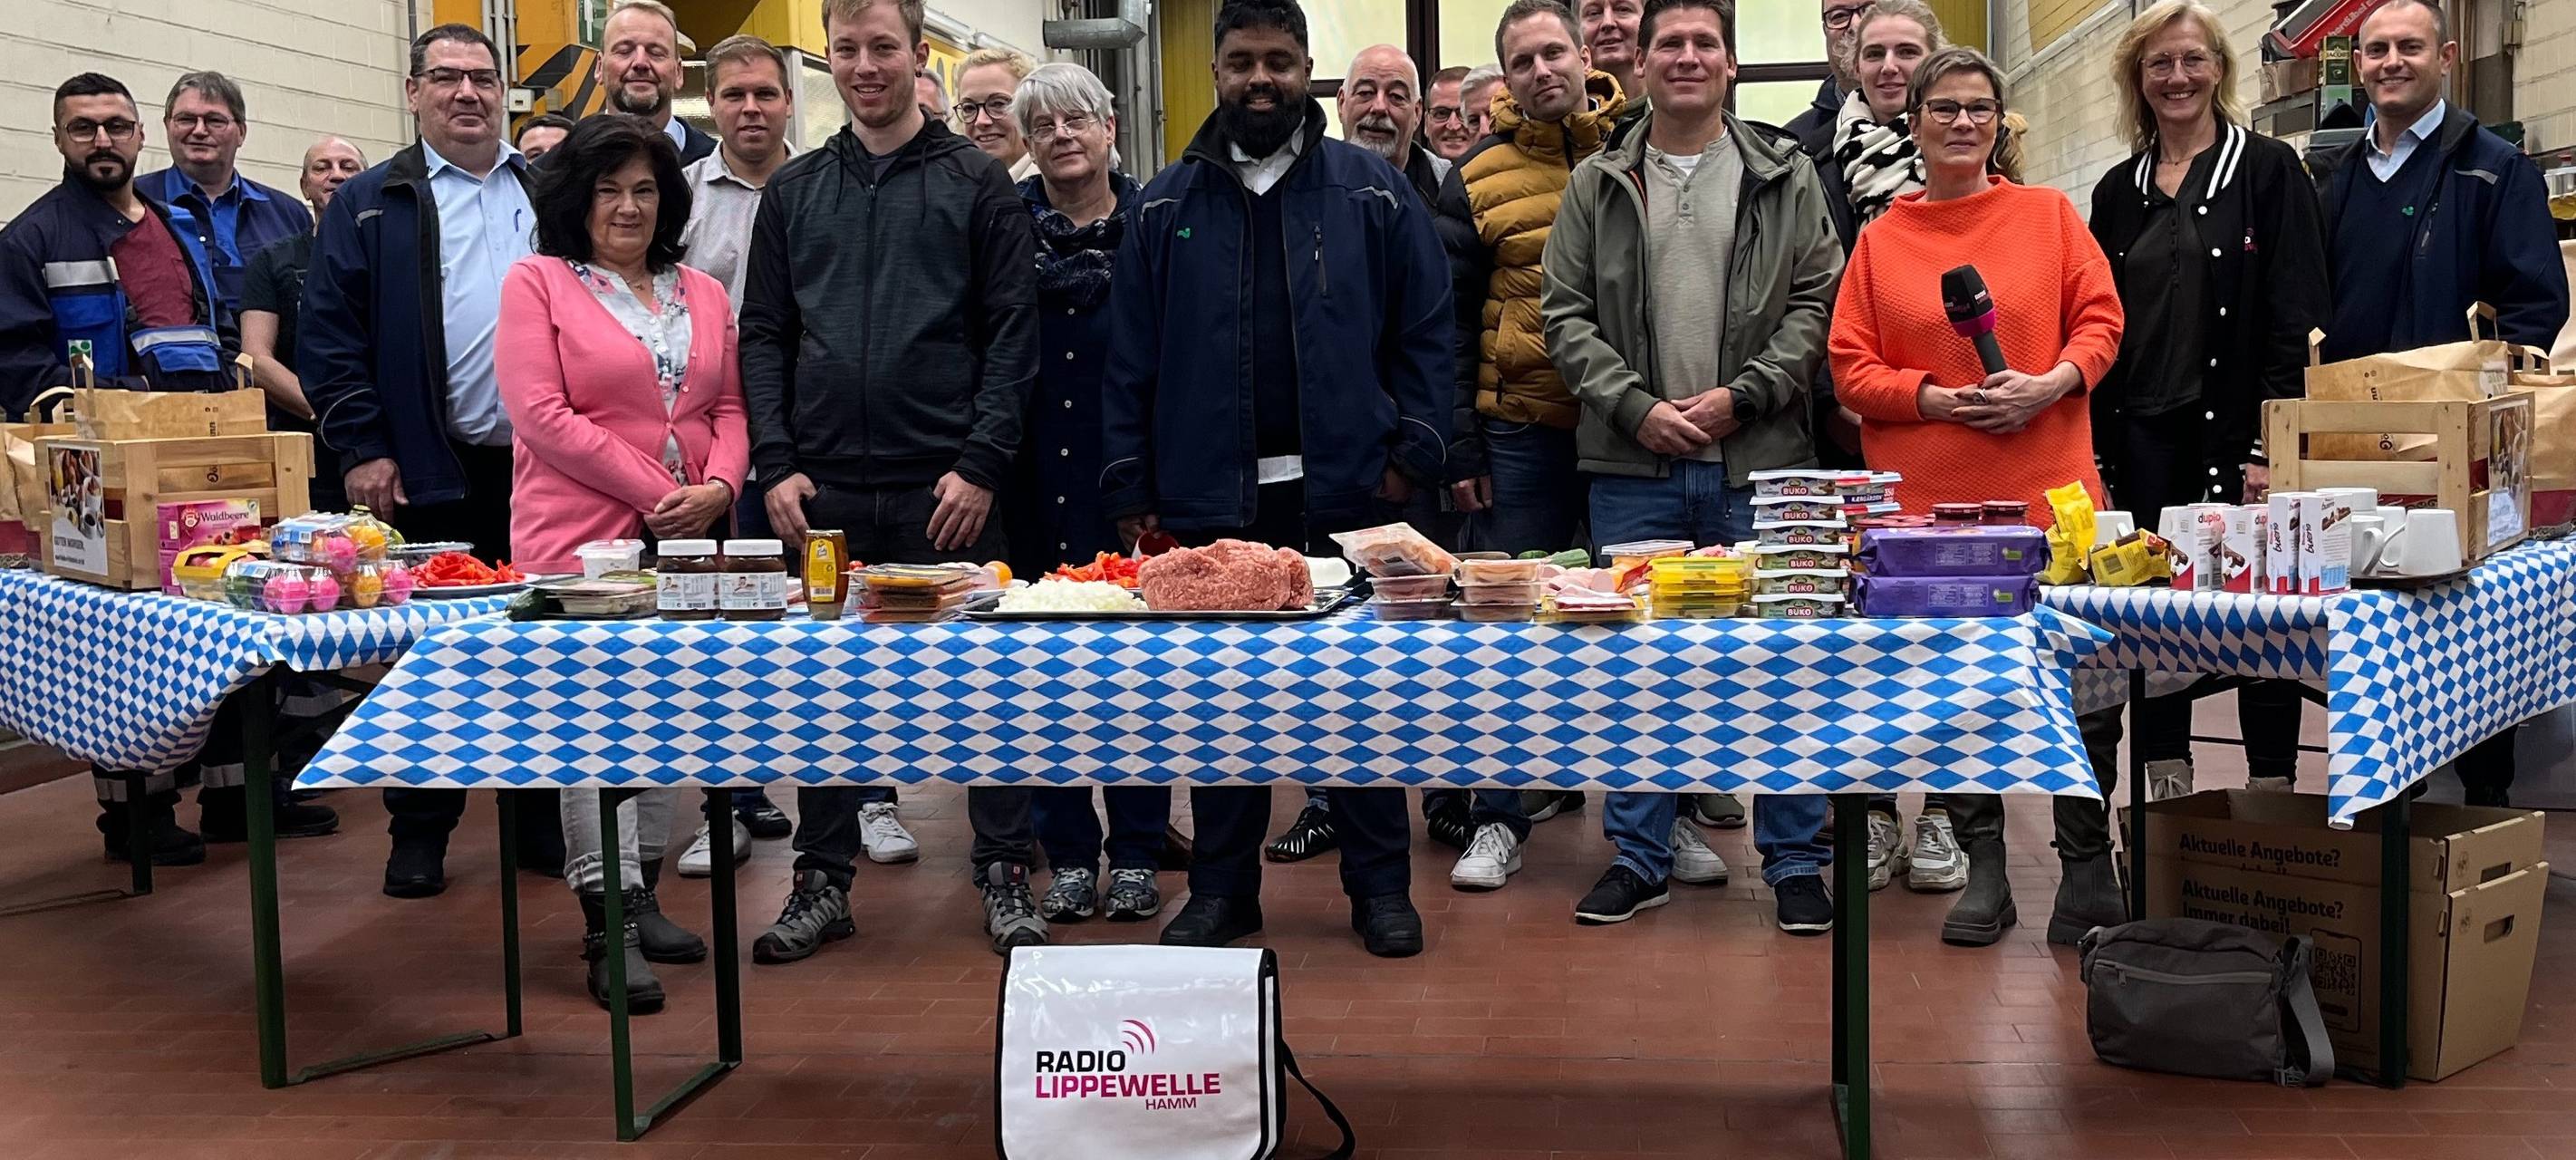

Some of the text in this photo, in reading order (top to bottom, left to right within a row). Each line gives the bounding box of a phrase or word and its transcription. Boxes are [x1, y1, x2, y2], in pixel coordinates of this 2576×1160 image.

[1782, 487, 1808, 495] BUKO
[200, 511, 249, 523] Waldbeere
[1783, 511, 1809, 519] BUKO
[2198, 511, 2222, 526] duplo
[1788, 536, 1813, 544] BUKO
[2272, 522, 2282, 553] bueno
[2305, 523, 2315, 554] bueno
[1790, 559, 1815, 567] BUKO
[1789, 585, 1813, 593] BUKO
[1787, 608, 1812, 616] BUKO
[2179, 833, 2341, 867] Aktuelle Angebote?
[2182, 879, 2344, 919] Aktuelle Angebote?
[2183, 901, 2291, 935] Immer dabei!
[1036, 1049, 1126, 1073] RADIO
[1036, 1072, 1221, 1098] LIPPEWELLE
[1145, 1097, 1197, 1110] HAMM
